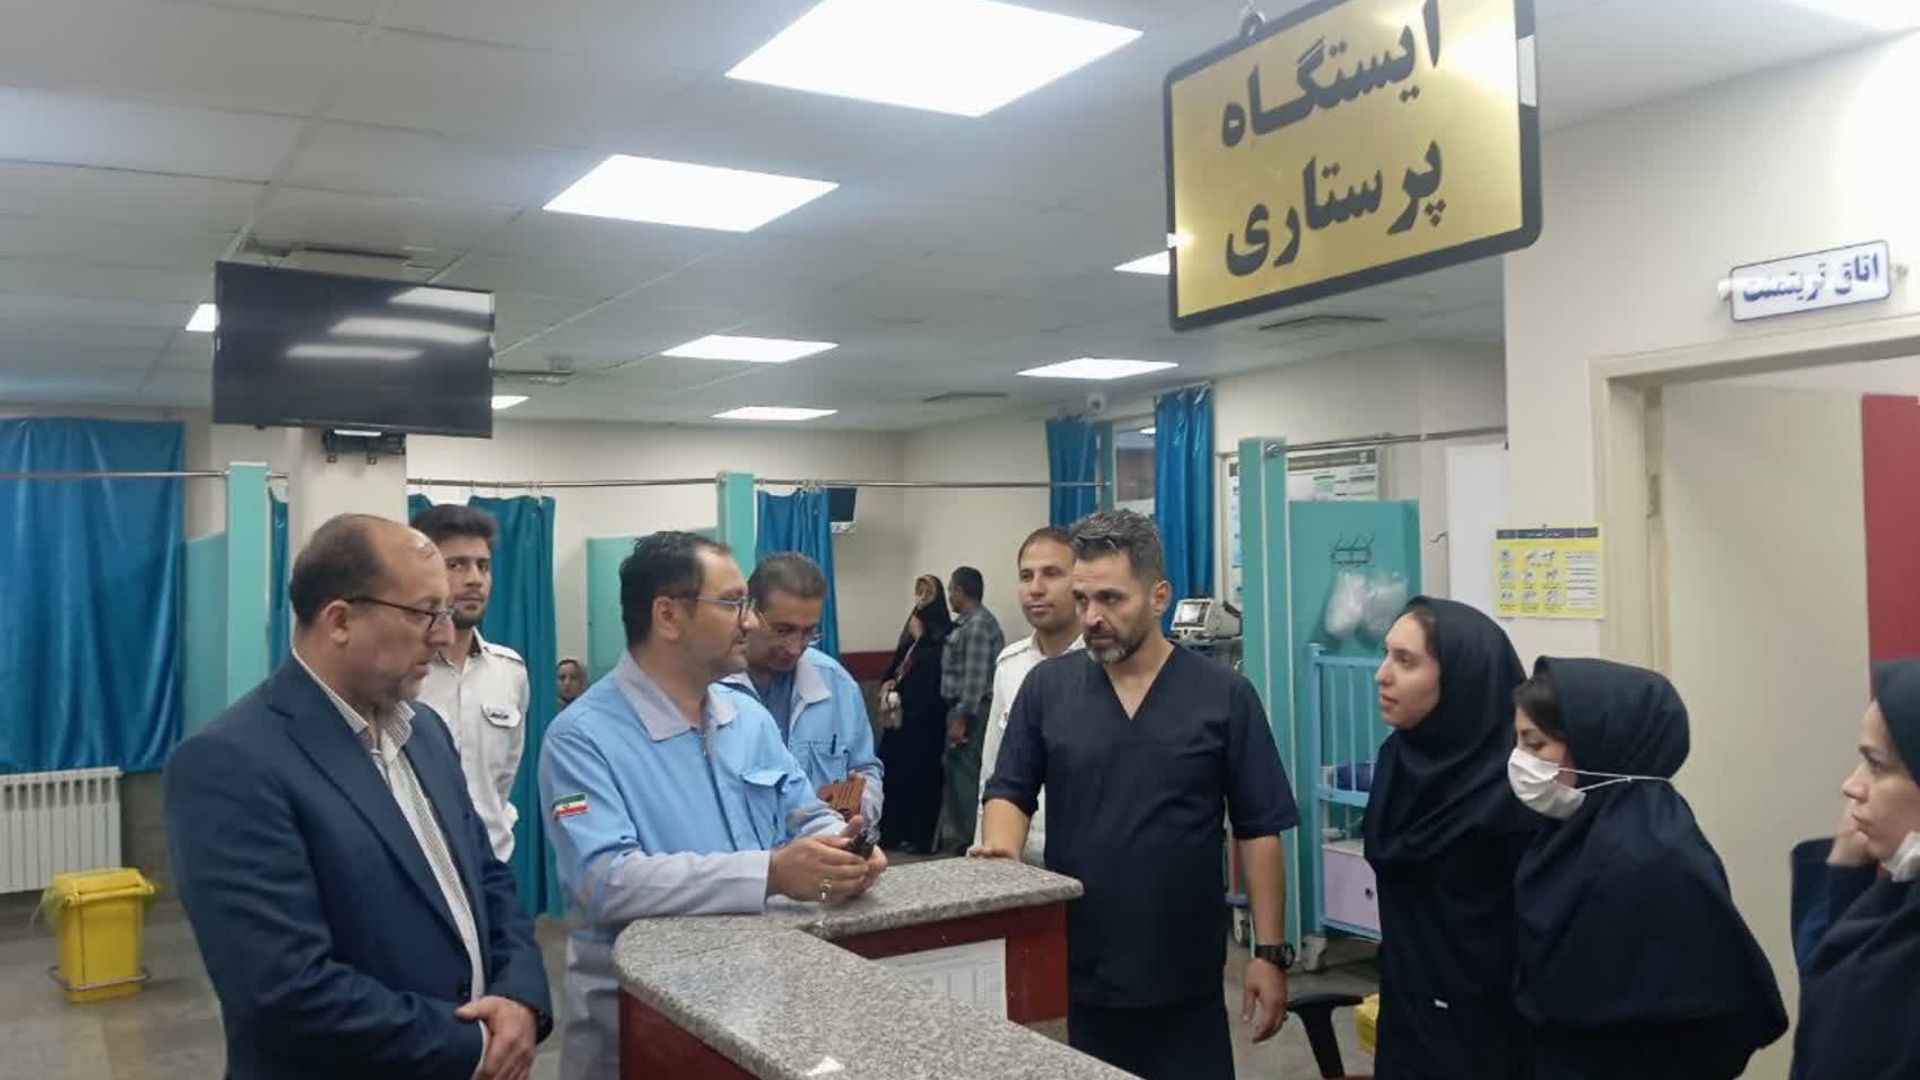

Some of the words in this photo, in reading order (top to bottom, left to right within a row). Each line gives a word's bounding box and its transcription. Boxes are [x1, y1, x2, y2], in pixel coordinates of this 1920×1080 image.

[1221, 0, 1441, 147] ایستگاه
[1225, 140, 1447, 276] پرستاری
[1834, 252, 1879, 295] اتاق
